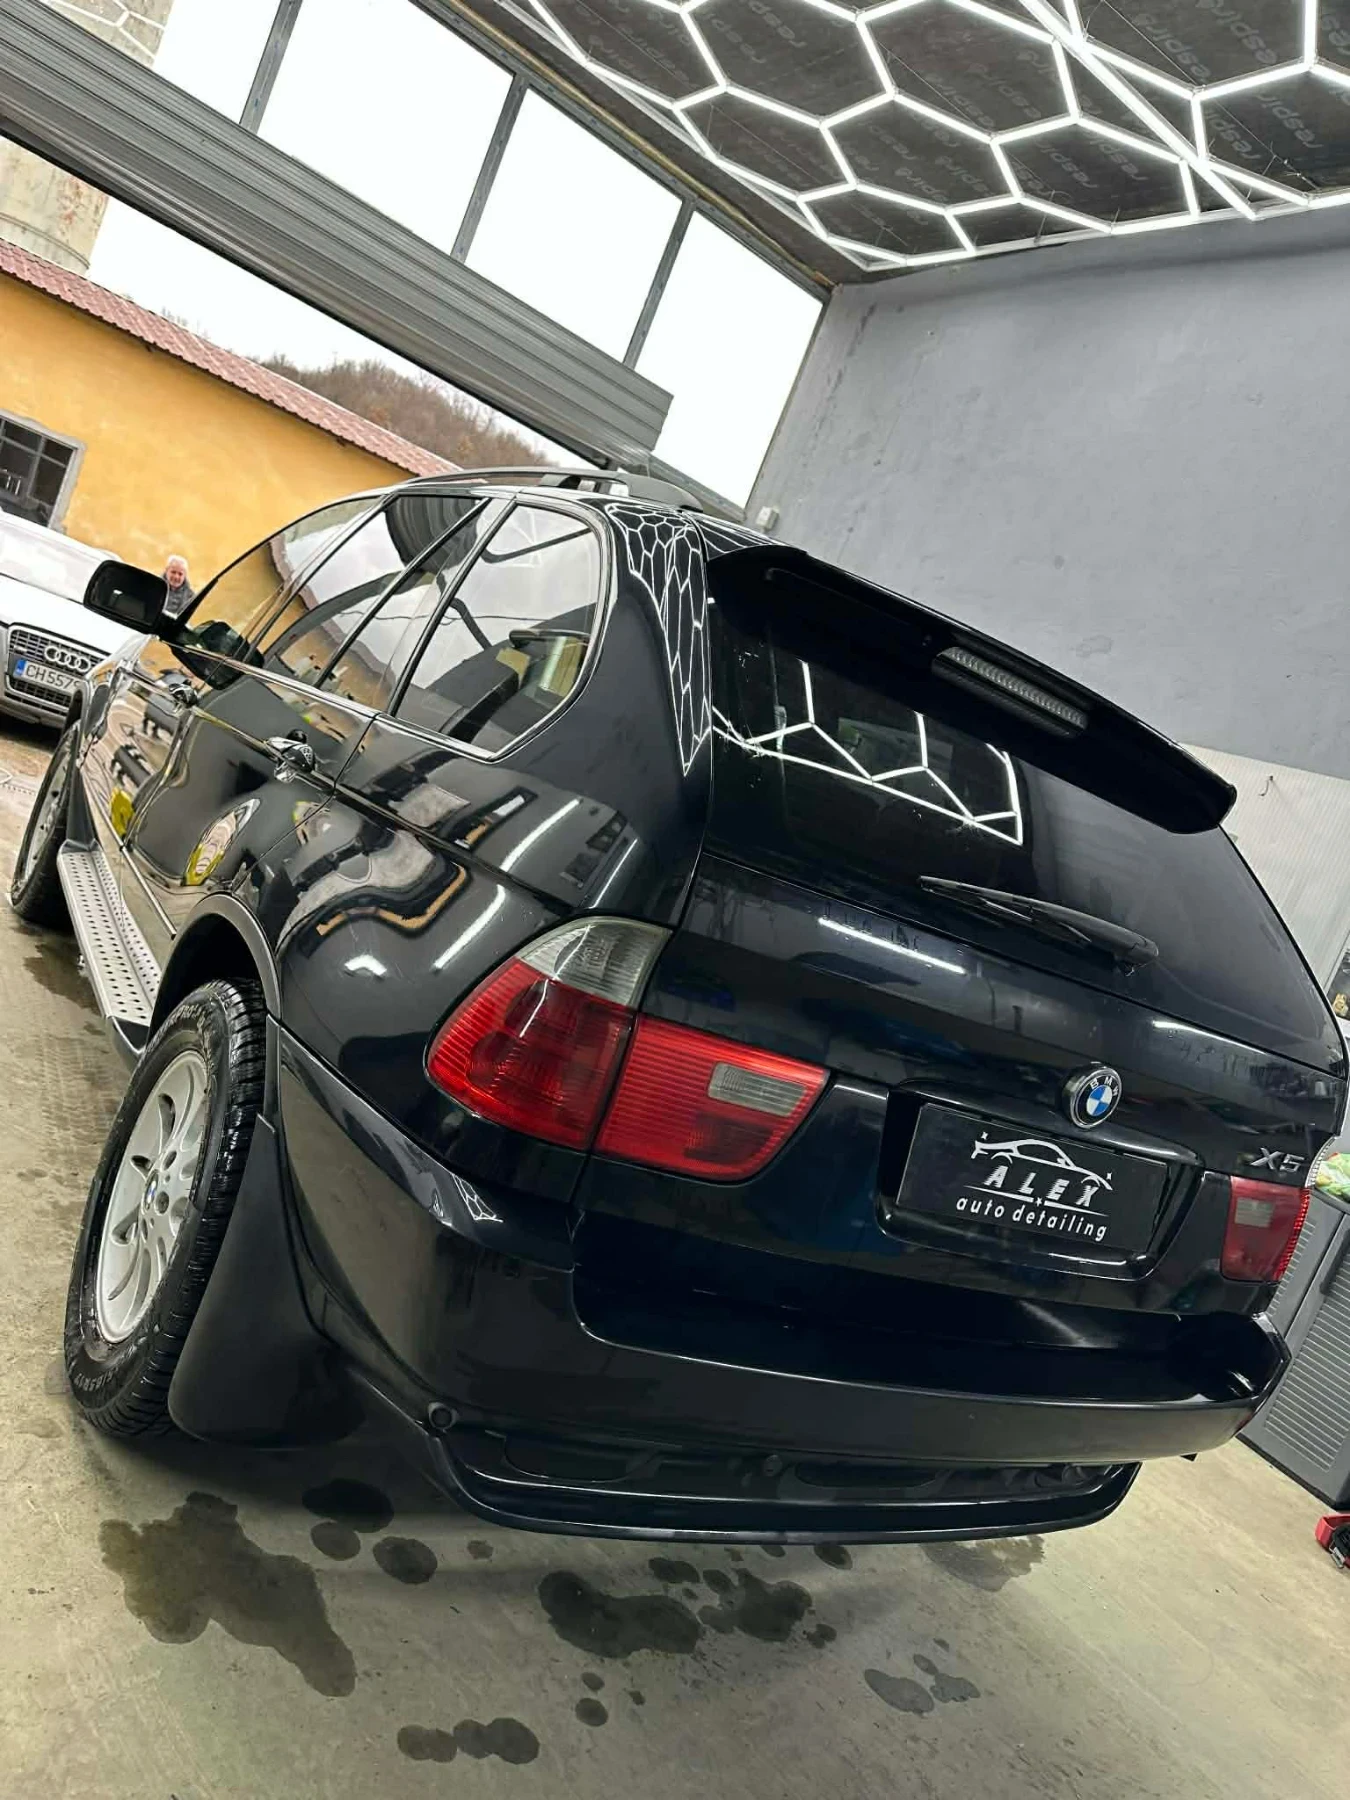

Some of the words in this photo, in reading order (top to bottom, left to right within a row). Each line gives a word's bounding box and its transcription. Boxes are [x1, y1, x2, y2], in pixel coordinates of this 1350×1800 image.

[1090, 1076, 1119, 1096] BMW
[1250, 1147, 1305, 1172] X5
[983, 1165, 1099, 1207] ALEX
[956, 1198, 1005, 1217] auto
[1012, 1204, 1107, 1242] detailing
